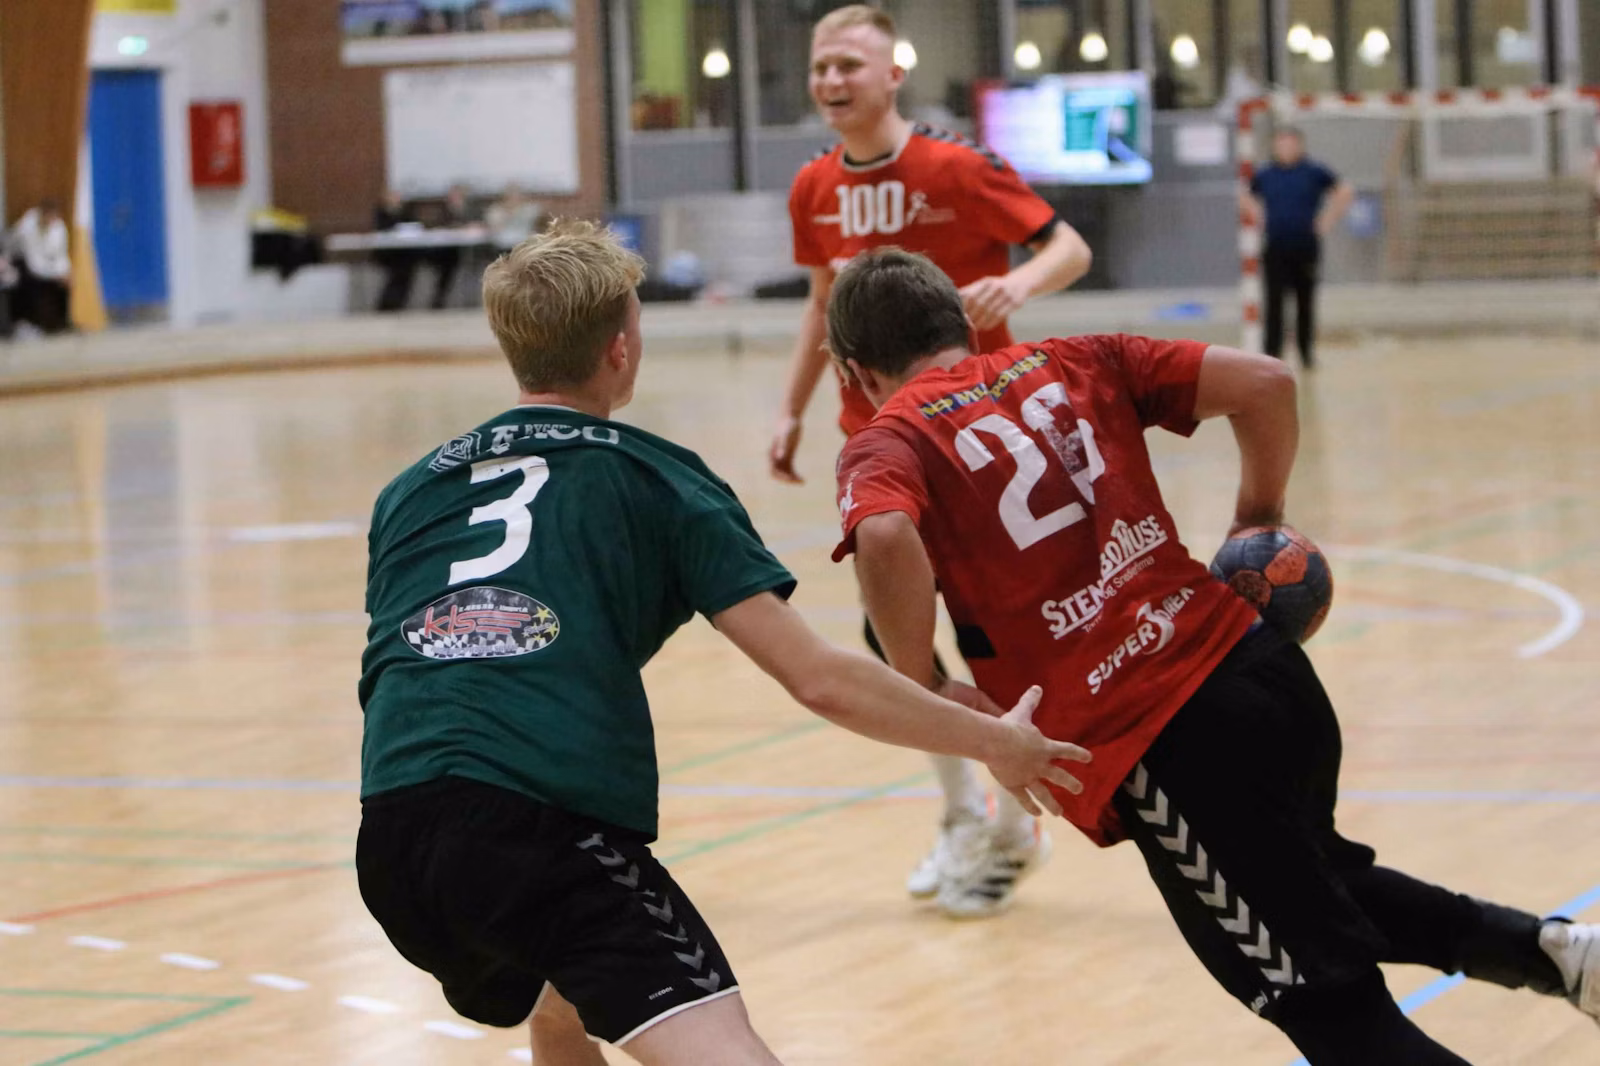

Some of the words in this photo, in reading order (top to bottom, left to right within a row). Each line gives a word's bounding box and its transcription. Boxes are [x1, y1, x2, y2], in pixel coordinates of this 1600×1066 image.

[834, 180, 905, 239] 100
[448, 455, 550, 586] 3
[1087, 622, 1158, 695] SUPER
